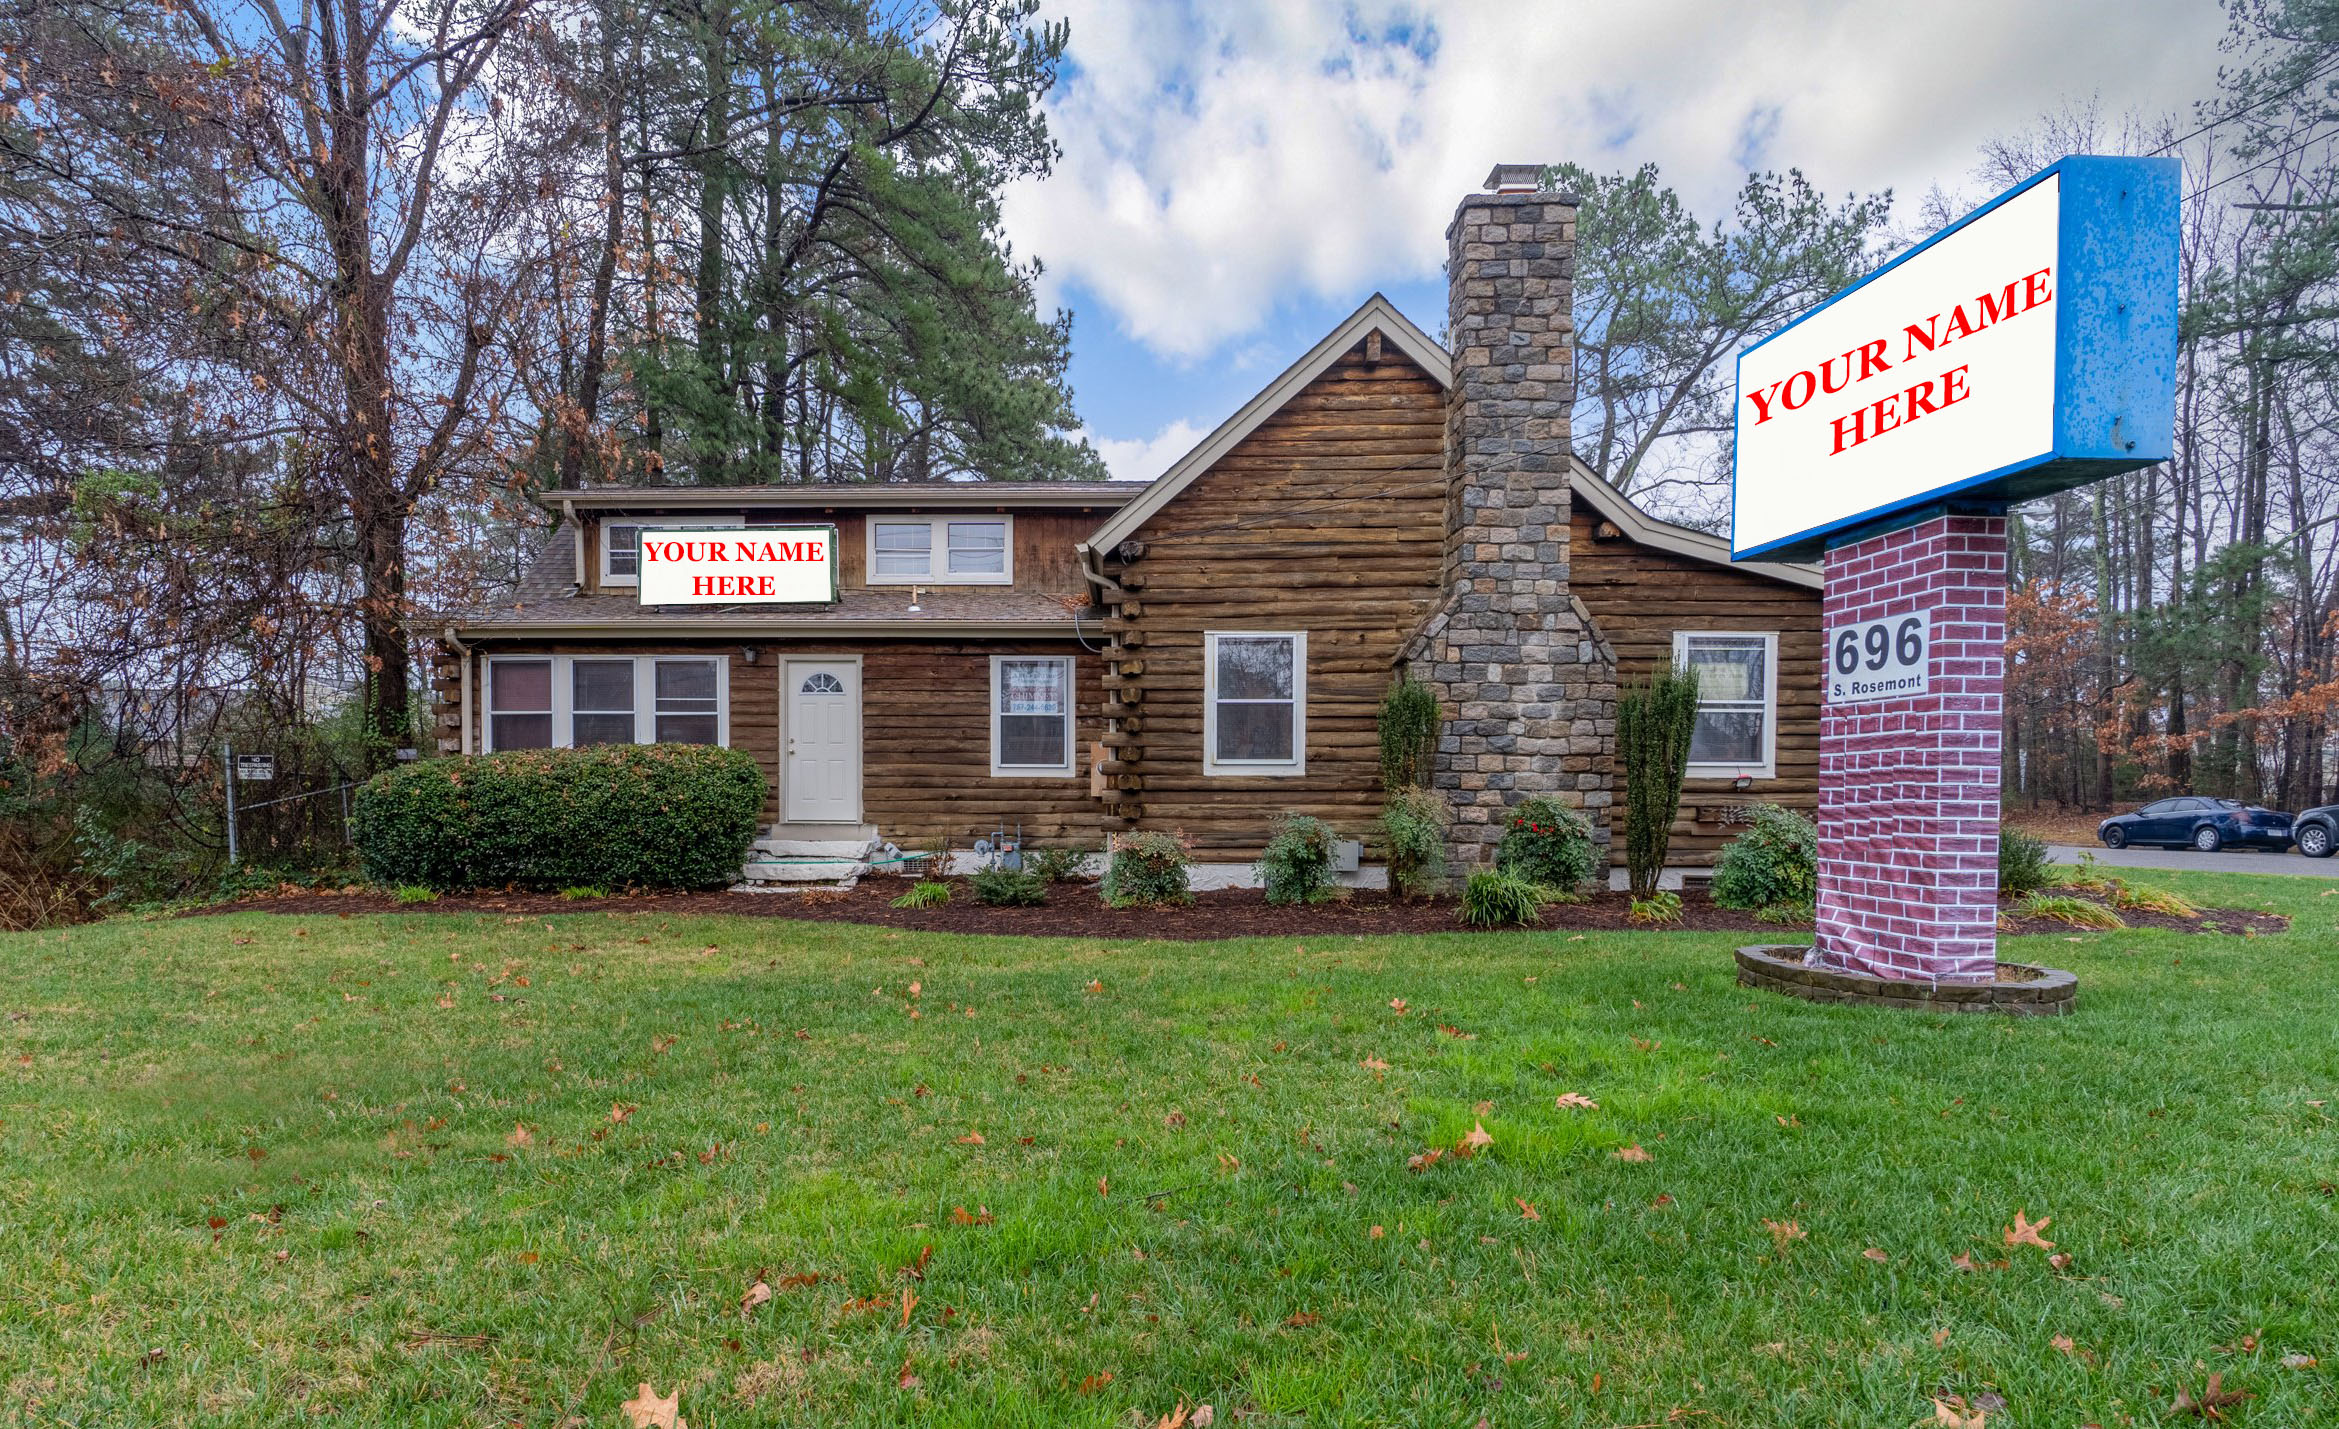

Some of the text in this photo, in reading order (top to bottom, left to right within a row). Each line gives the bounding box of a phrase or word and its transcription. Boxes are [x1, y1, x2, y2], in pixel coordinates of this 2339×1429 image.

[1746, 268, 2052, 426] YOUR NAME
[1830, 365, 1970, 456] HERE
[643, 542, 824, 562] YOUR NAME
[692, 576, 776, 596] HERE
[1836, 617, 1922, 675] 696
[1833, 674, 1922, 697] S. Rosemont
